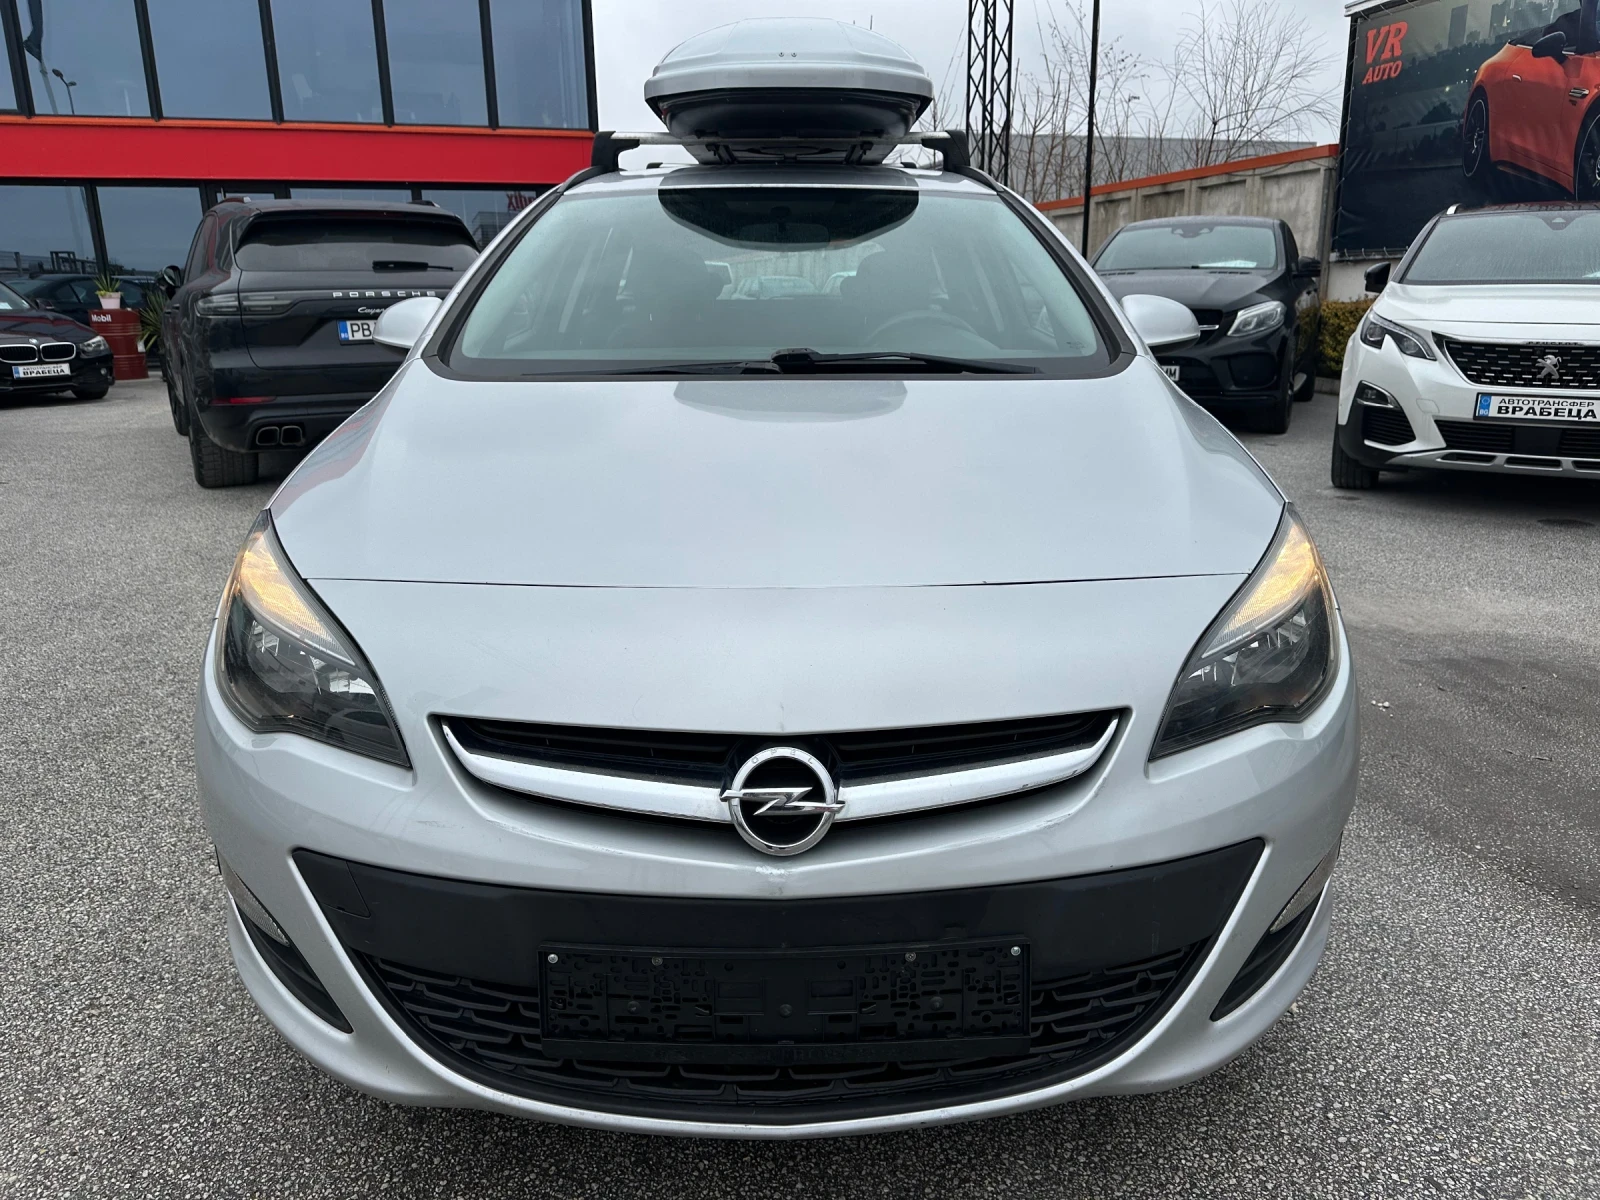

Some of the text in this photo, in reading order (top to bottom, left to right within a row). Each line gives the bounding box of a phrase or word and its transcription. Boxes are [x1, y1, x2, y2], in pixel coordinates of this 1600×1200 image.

[1365, 21, 1408, 64] VR
[1362, 61, 1402, 85] AUTO
[333, 290, 436, 298] PORSCHE
[91, 314, 112, 322] Mobil
[22, 368, 66, 376] ВРАБЕЦА
[1498, 398, 1595, 408] АВТОТРАНСФЕР
[1497, 405, 1598, 420] ВРАБЕЦА
[751, 748, 813, 764] OPEL
